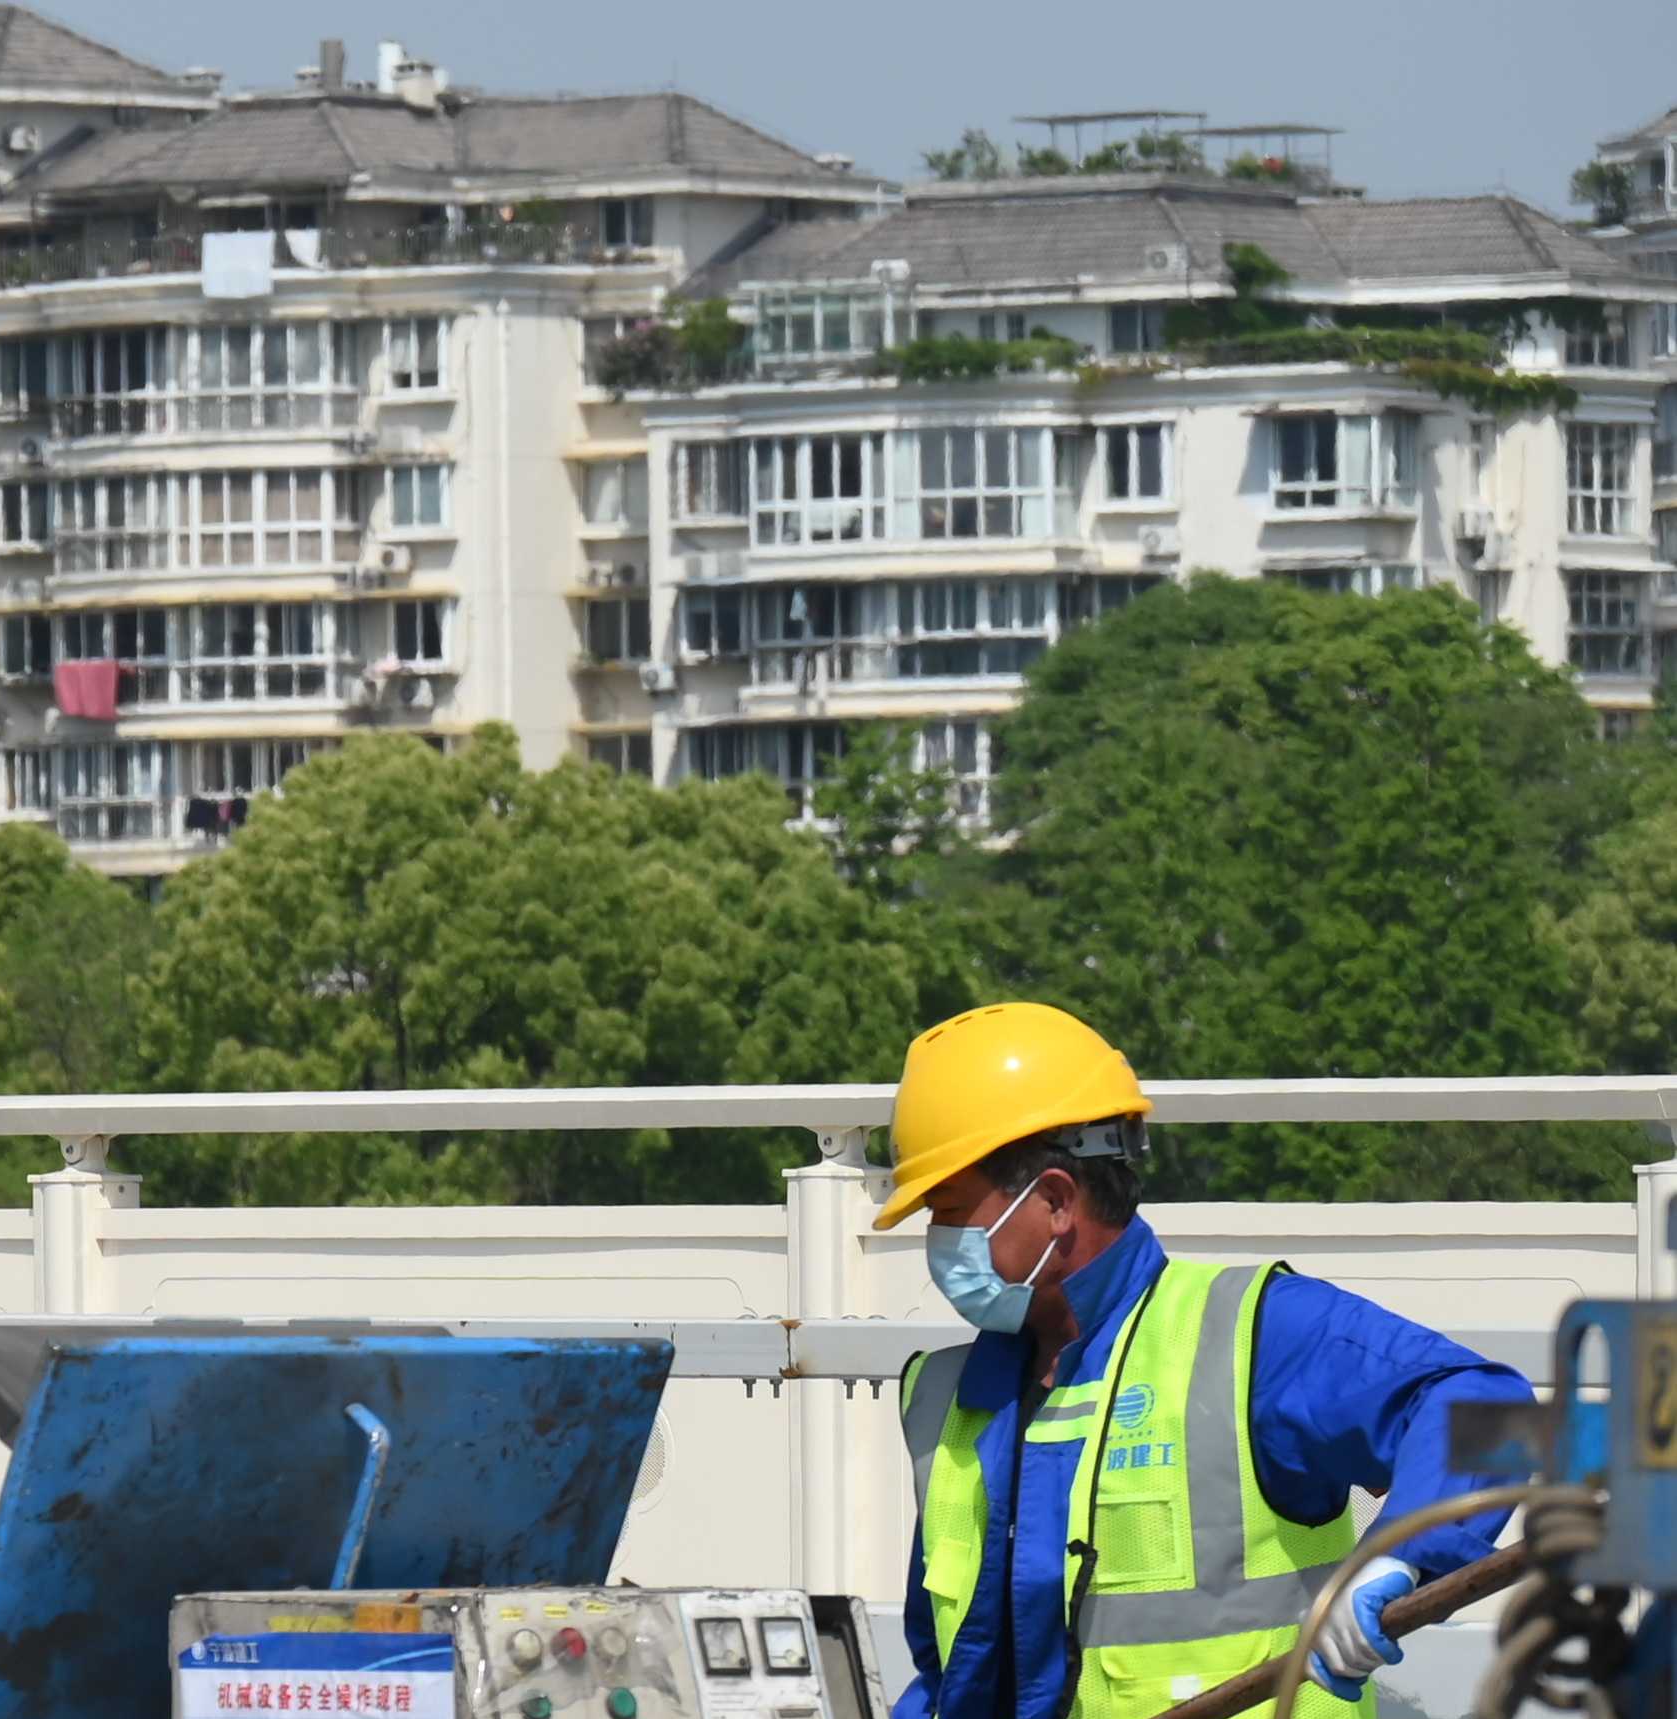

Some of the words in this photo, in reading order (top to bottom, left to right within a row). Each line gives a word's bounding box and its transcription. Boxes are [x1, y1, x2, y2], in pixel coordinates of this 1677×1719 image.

[217, 1682, 413, 1712] 机械设备安全操作规程
